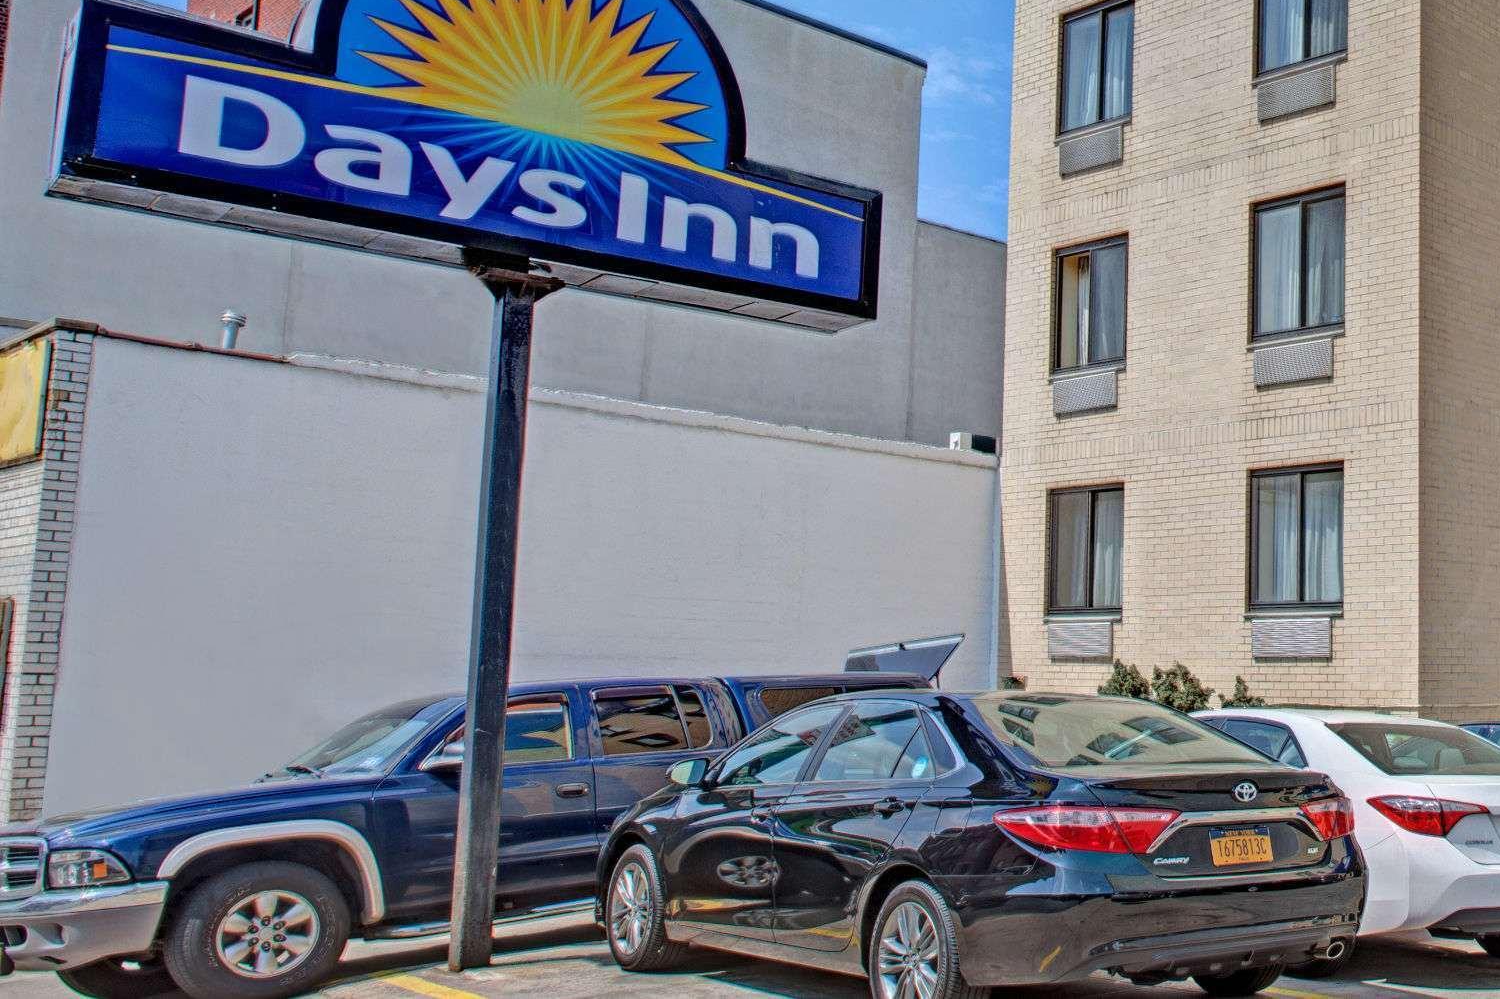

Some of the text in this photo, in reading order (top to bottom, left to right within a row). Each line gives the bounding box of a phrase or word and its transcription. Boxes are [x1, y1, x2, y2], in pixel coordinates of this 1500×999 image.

[177, 74, 821, 280] Days Inn
[1216, 837, 1267, 858] T675813C
[1153, 856, 1191, 865] CAMRY
